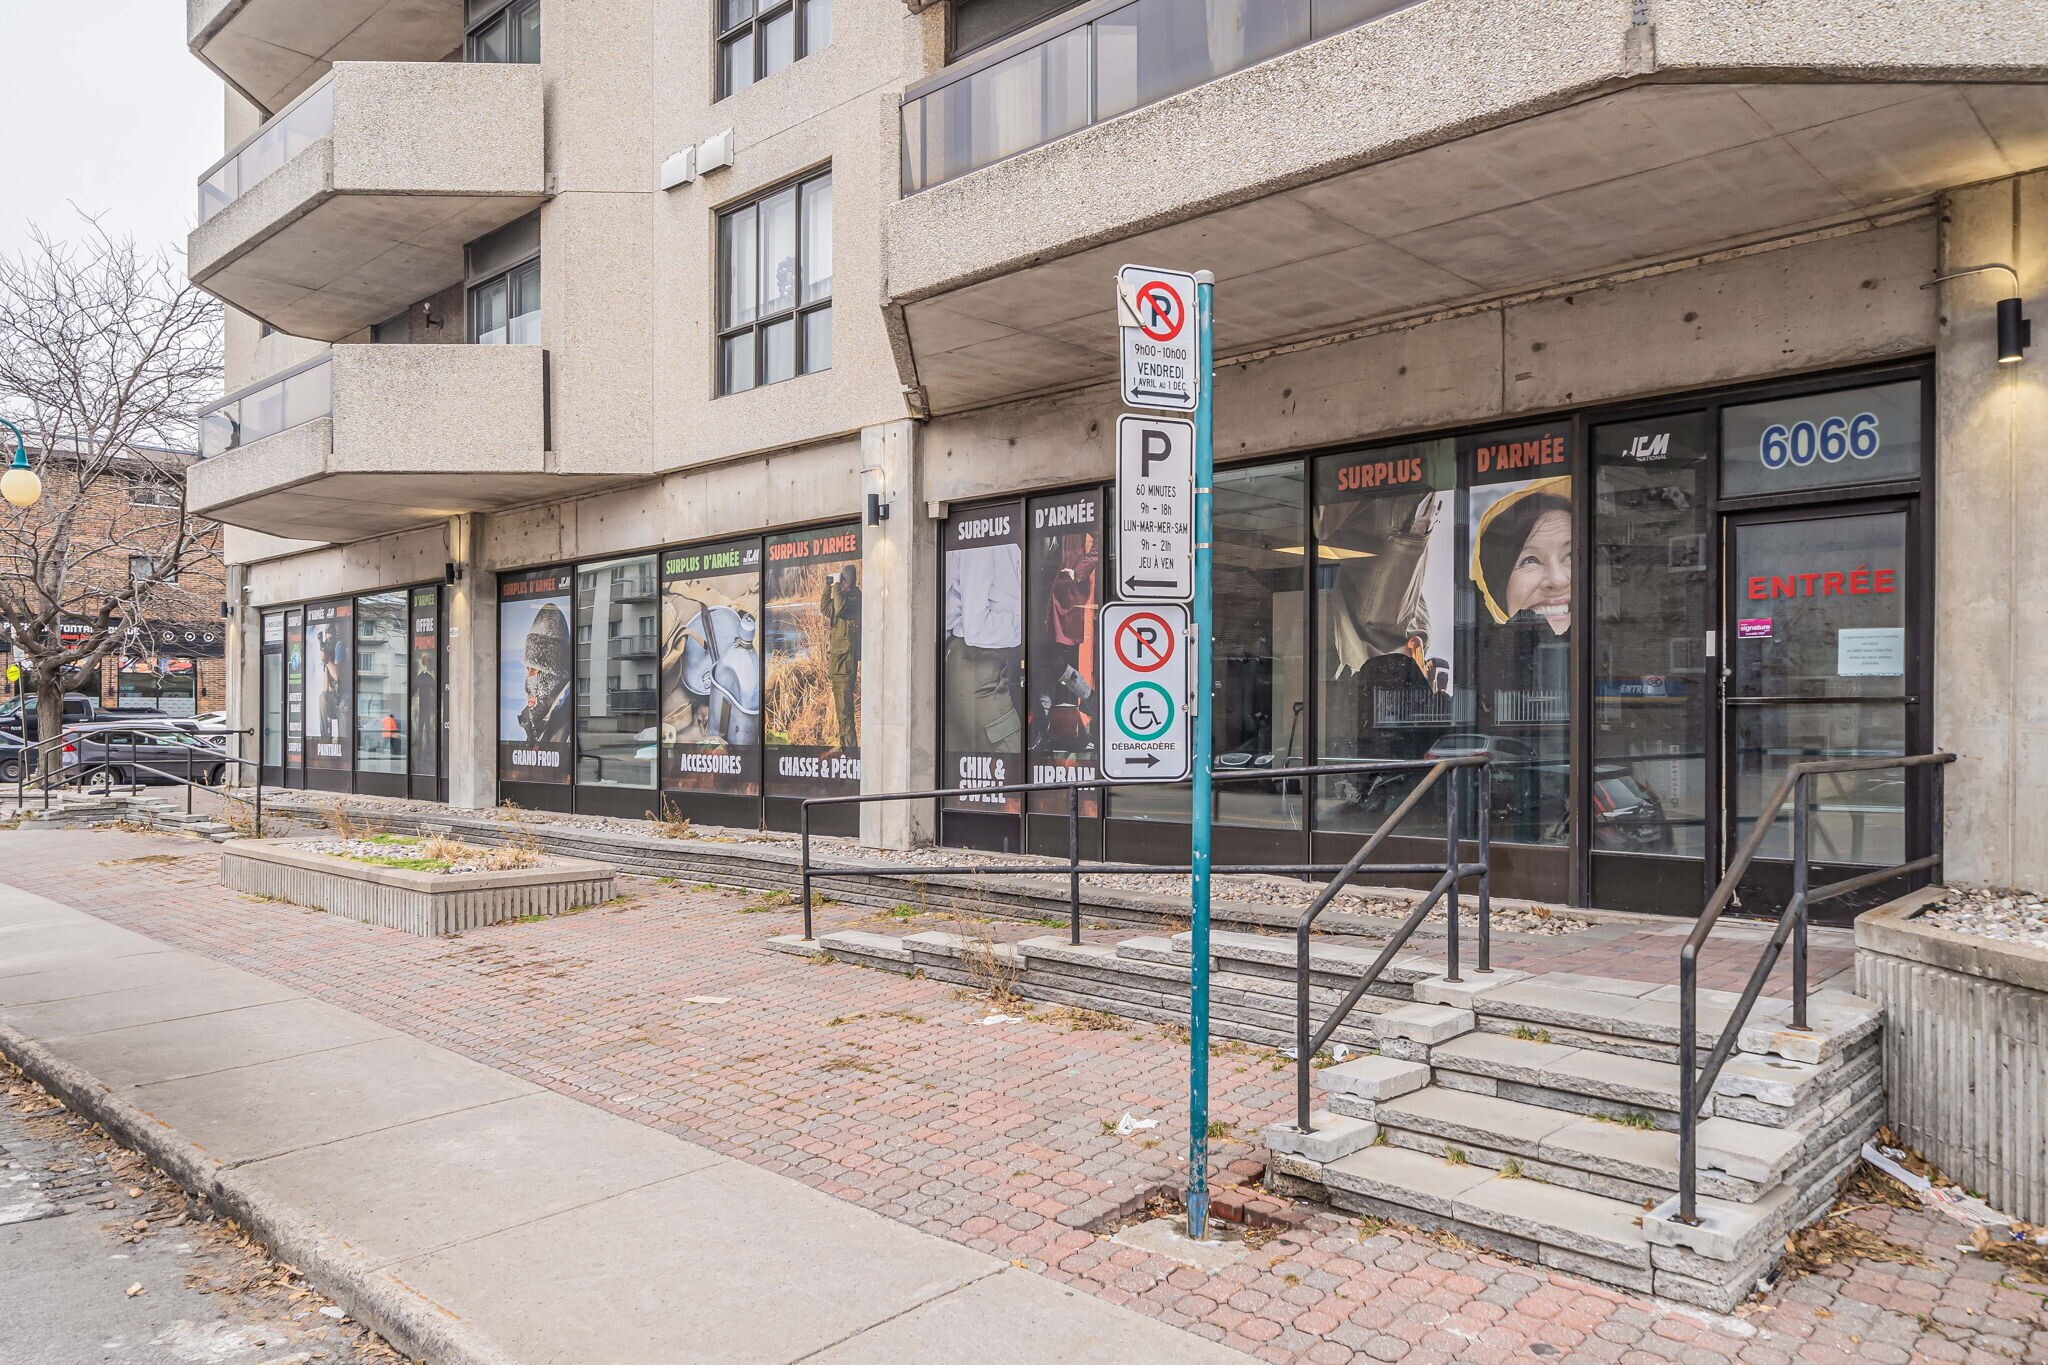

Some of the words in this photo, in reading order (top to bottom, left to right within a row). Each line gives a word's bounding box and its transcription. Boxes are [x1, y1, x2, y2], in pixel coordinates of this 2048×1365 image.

[1138, 362, 1184, 379] VENDREDI
[1138, 378, 1157, 388] AVRIL
[1759, 411, 1880, 470] 6066
[1141, 429, 1172, 478] P
[1337, 457, 1423, 492] SURPLUS
[1477, 433, 1566, 473] D'ARMÉE
[1636, 454, 1668, 462] NATIONAL
[1136, 484, 1146, 496] 60
[1148, 485, 1176, 498] MINUTES
[1140, 502, 1149, 515] 9h
[1161, 503, 1172, 516] 18h
[958, 516, 1011, 541] SURPLUS
[1035, 498, 1096, 530] D'ARMÉE
[1123, 520, 1188, 535] LUN-MAR-MER-SAM
[769, 541, 809, 561] SURPLUS
[813, 532, 856, 556] D'ARMÉE
[1141, 539, 1150, 551] 9h
[666, 556, 700, 575] SURPLUS
[703, 548, 740, 570] D'ARMÉE
[1138, 556, 1152, 569] JEU
[1154, 554, 1159, 569] À
[1160, 557, 1174, 570] VEN
[503, 581, 528, 596] SURPLUS
[530, 576, 556, 593] D'ARMÉE
[1747, 565, 1897, 600] ENTRÉE
[416, 618, 434, 632] OFFRE
[1111, 742, 1176, 751] DÉBARCADÈRE
[512, 750, 537, 767] GRAND
[537, 751, 560, 768] FROID
[680, 753, 742, 776] ACCESSOIRES
[779, 756, 819, 778] CHASSE
[820, 760, 830, 778] &
[831, 755, 861, 780] PÊCH
[959, 756, 992, 780] CHIK
[994, 758, 1006, 780] &
[1033, 764, 1096, 791] URBAIN
